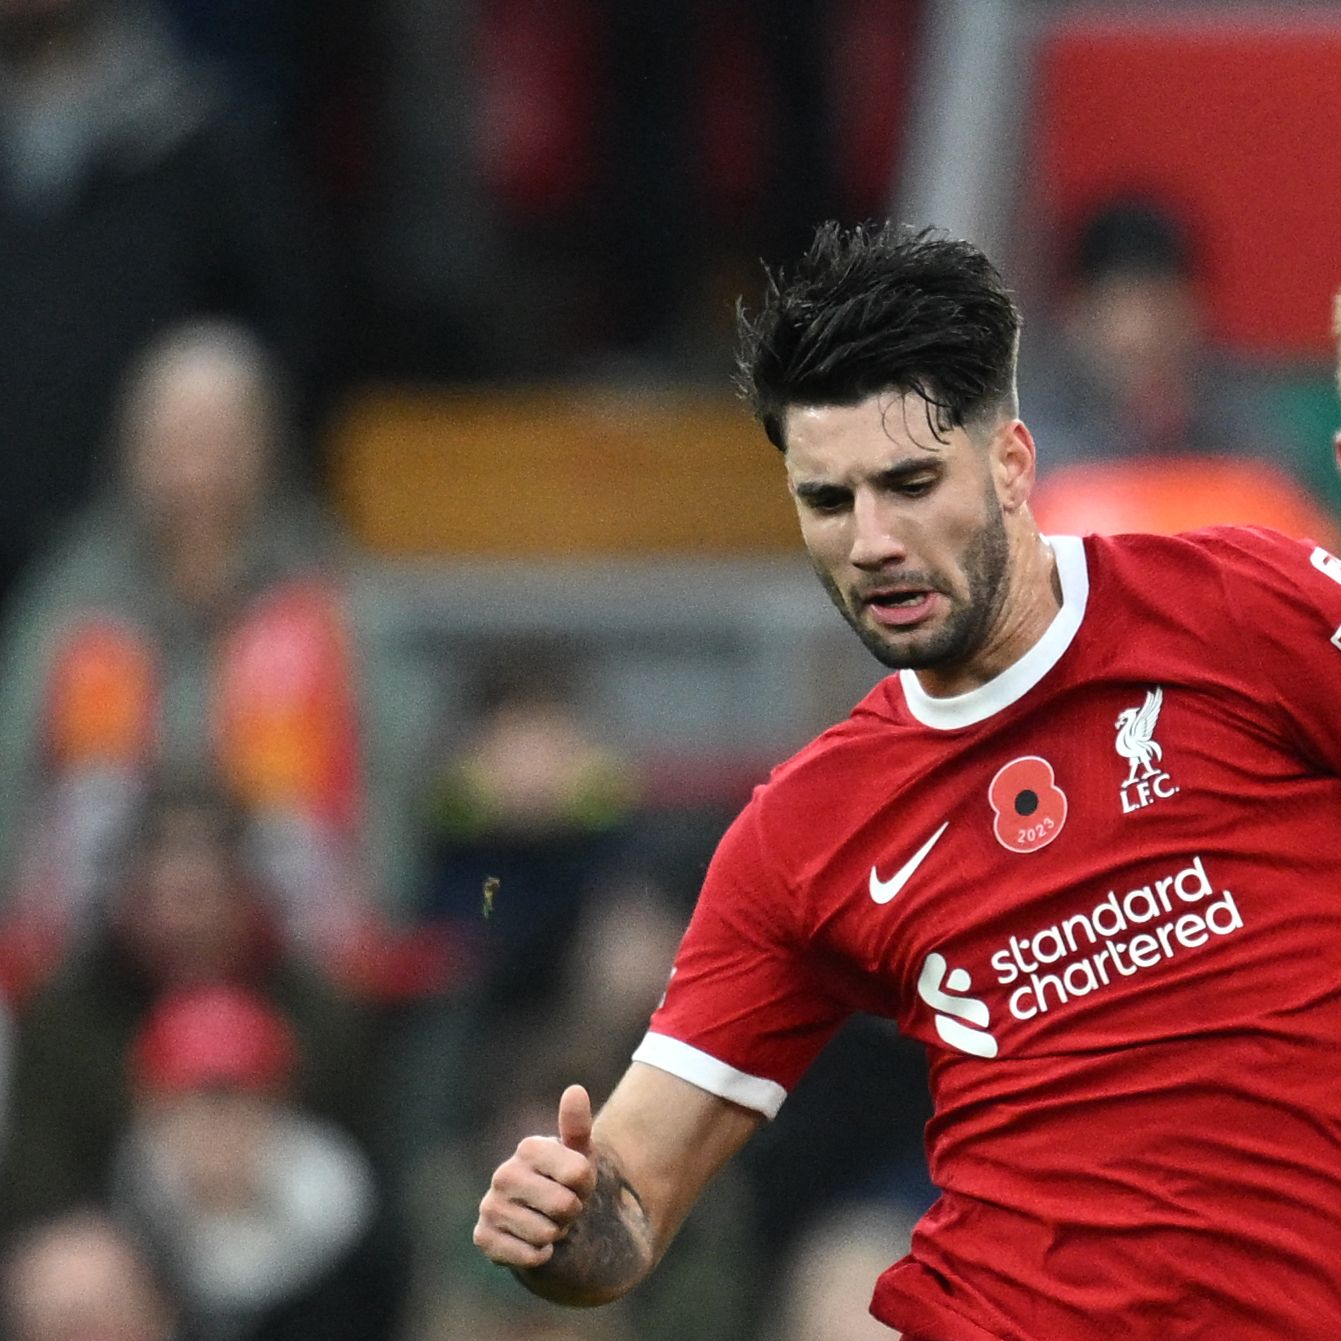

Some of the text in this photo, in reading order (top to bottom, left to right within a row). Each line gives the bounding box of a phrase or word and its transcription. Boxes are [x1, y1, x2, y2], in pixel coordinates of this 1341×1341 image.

[1017, 817, 1056, 844] 2023
[991, 856, 1213, 984] standard
[1009, 890, 1244, 1020] chartered
